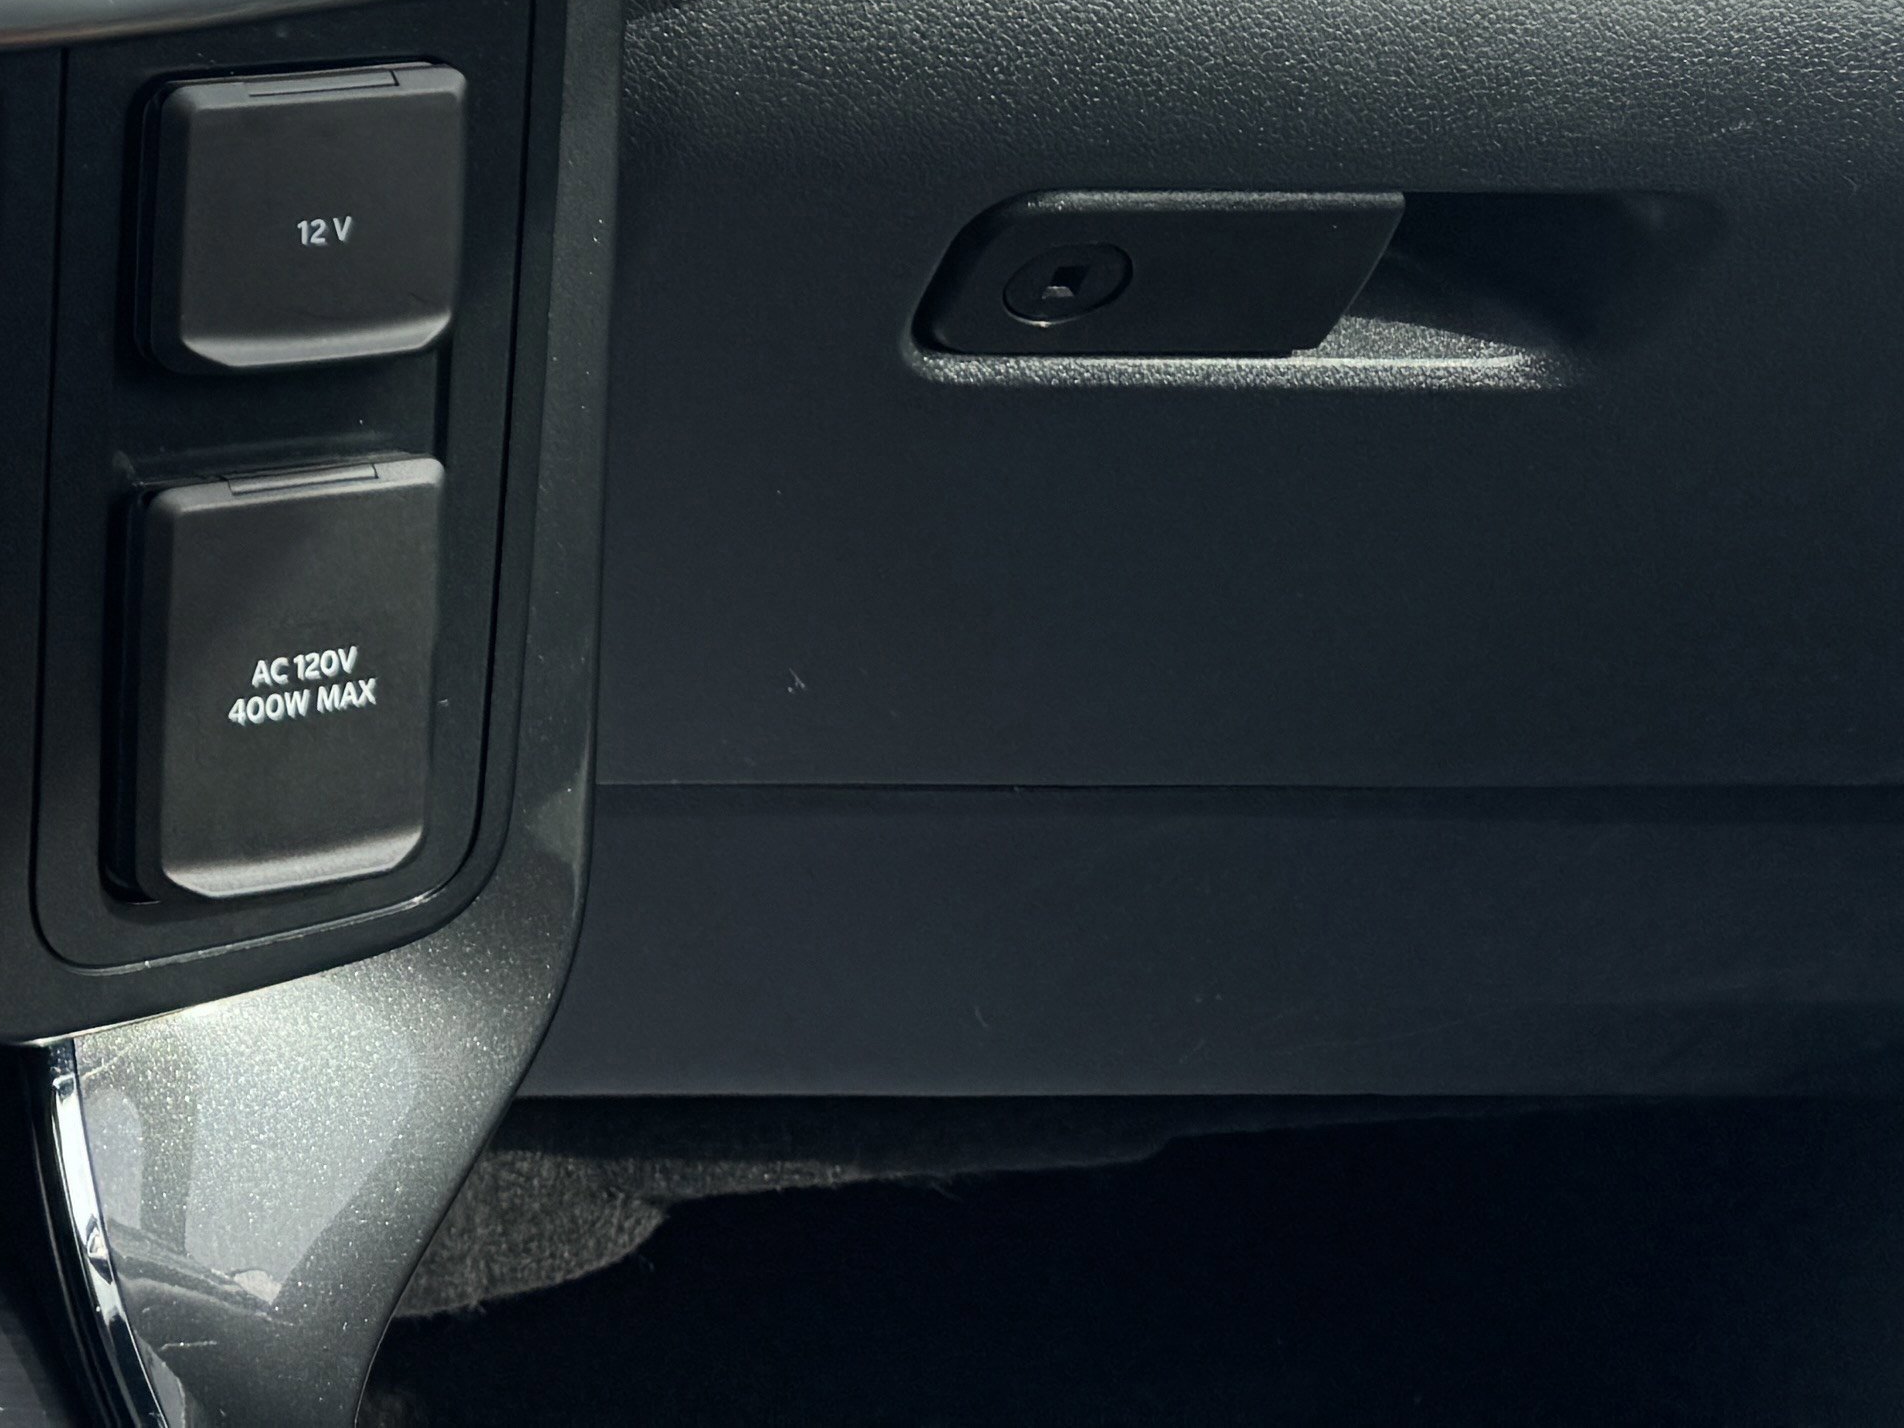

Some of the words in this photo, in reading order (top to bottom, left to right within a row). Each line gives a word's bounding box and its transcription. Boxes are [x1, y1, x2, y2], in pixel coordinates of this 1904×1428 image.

[298, 218, 326, 244] 12
[333, 216, 352, 241] V
[251, 657, 290, 688] AC
[292, 645, 358, 680] 120V
[227, 691, 311, 725] 400W
[316, 677, 377, 712] MAX
